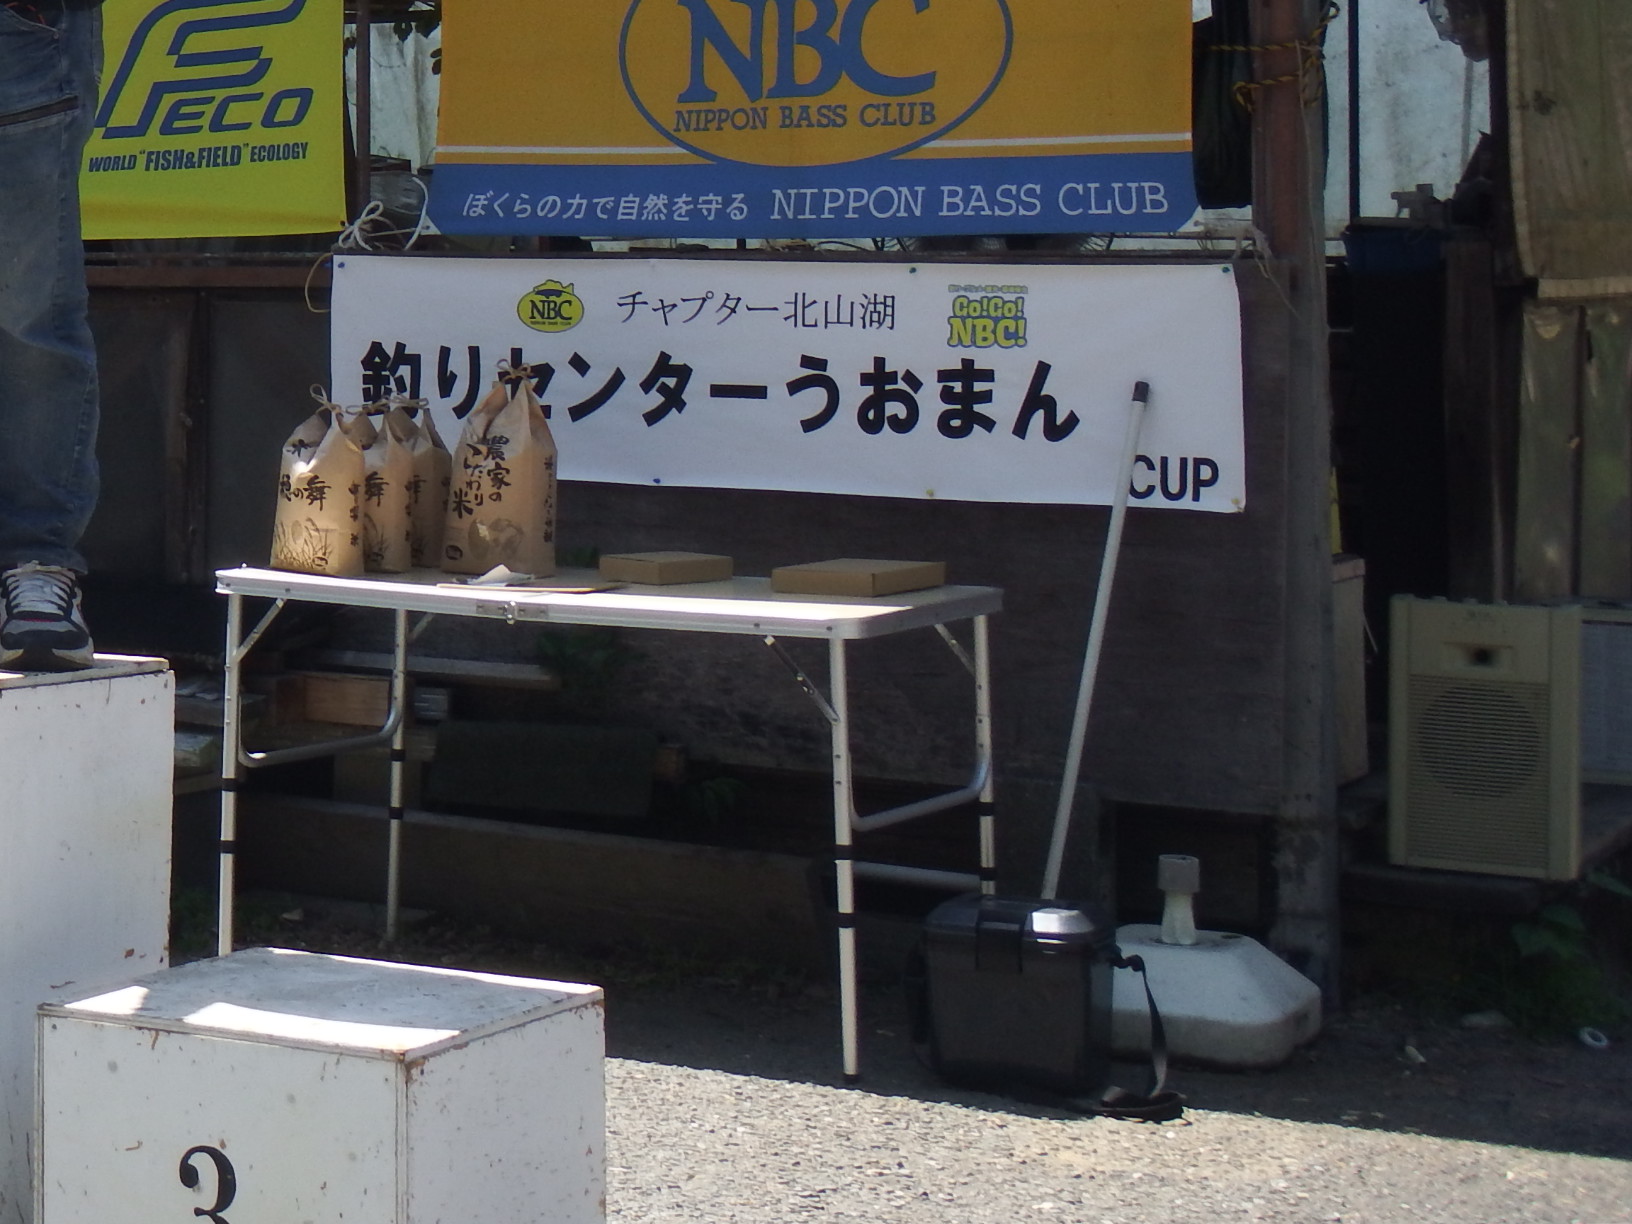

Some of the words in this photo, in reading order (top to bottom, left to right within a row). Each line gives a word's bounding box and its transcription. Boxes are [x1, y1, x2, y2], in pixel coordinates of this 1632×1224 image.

[674, 107, 768, 134] NIPPON
[779, 104, 848, 130] BASS
[859, 102, 937, 128] CLUB
[88, 155, 138, 173] WORLD
[250, 142, 309, 163] ECOLOGY
[462, 189, 749, 223] ぼくらの力で自然を守る
[771, 187, 923, 222] NIPPON
[940, 184, 1042, 219] BASS
[1058, 181, 1169, 216] CLUB
[528, 299, 573, 321] NBC
[616, 291, 897, 331] チャプター北山湖
[947, 316, 1028, 349] NBC!
[361, 340, 1081, 443] 釣りセンターうおまん
[484, 435, 511, 502] 農家の
[1129, 455, 1220, 502] CUP
[178, 1143, 238, 1224] 3
